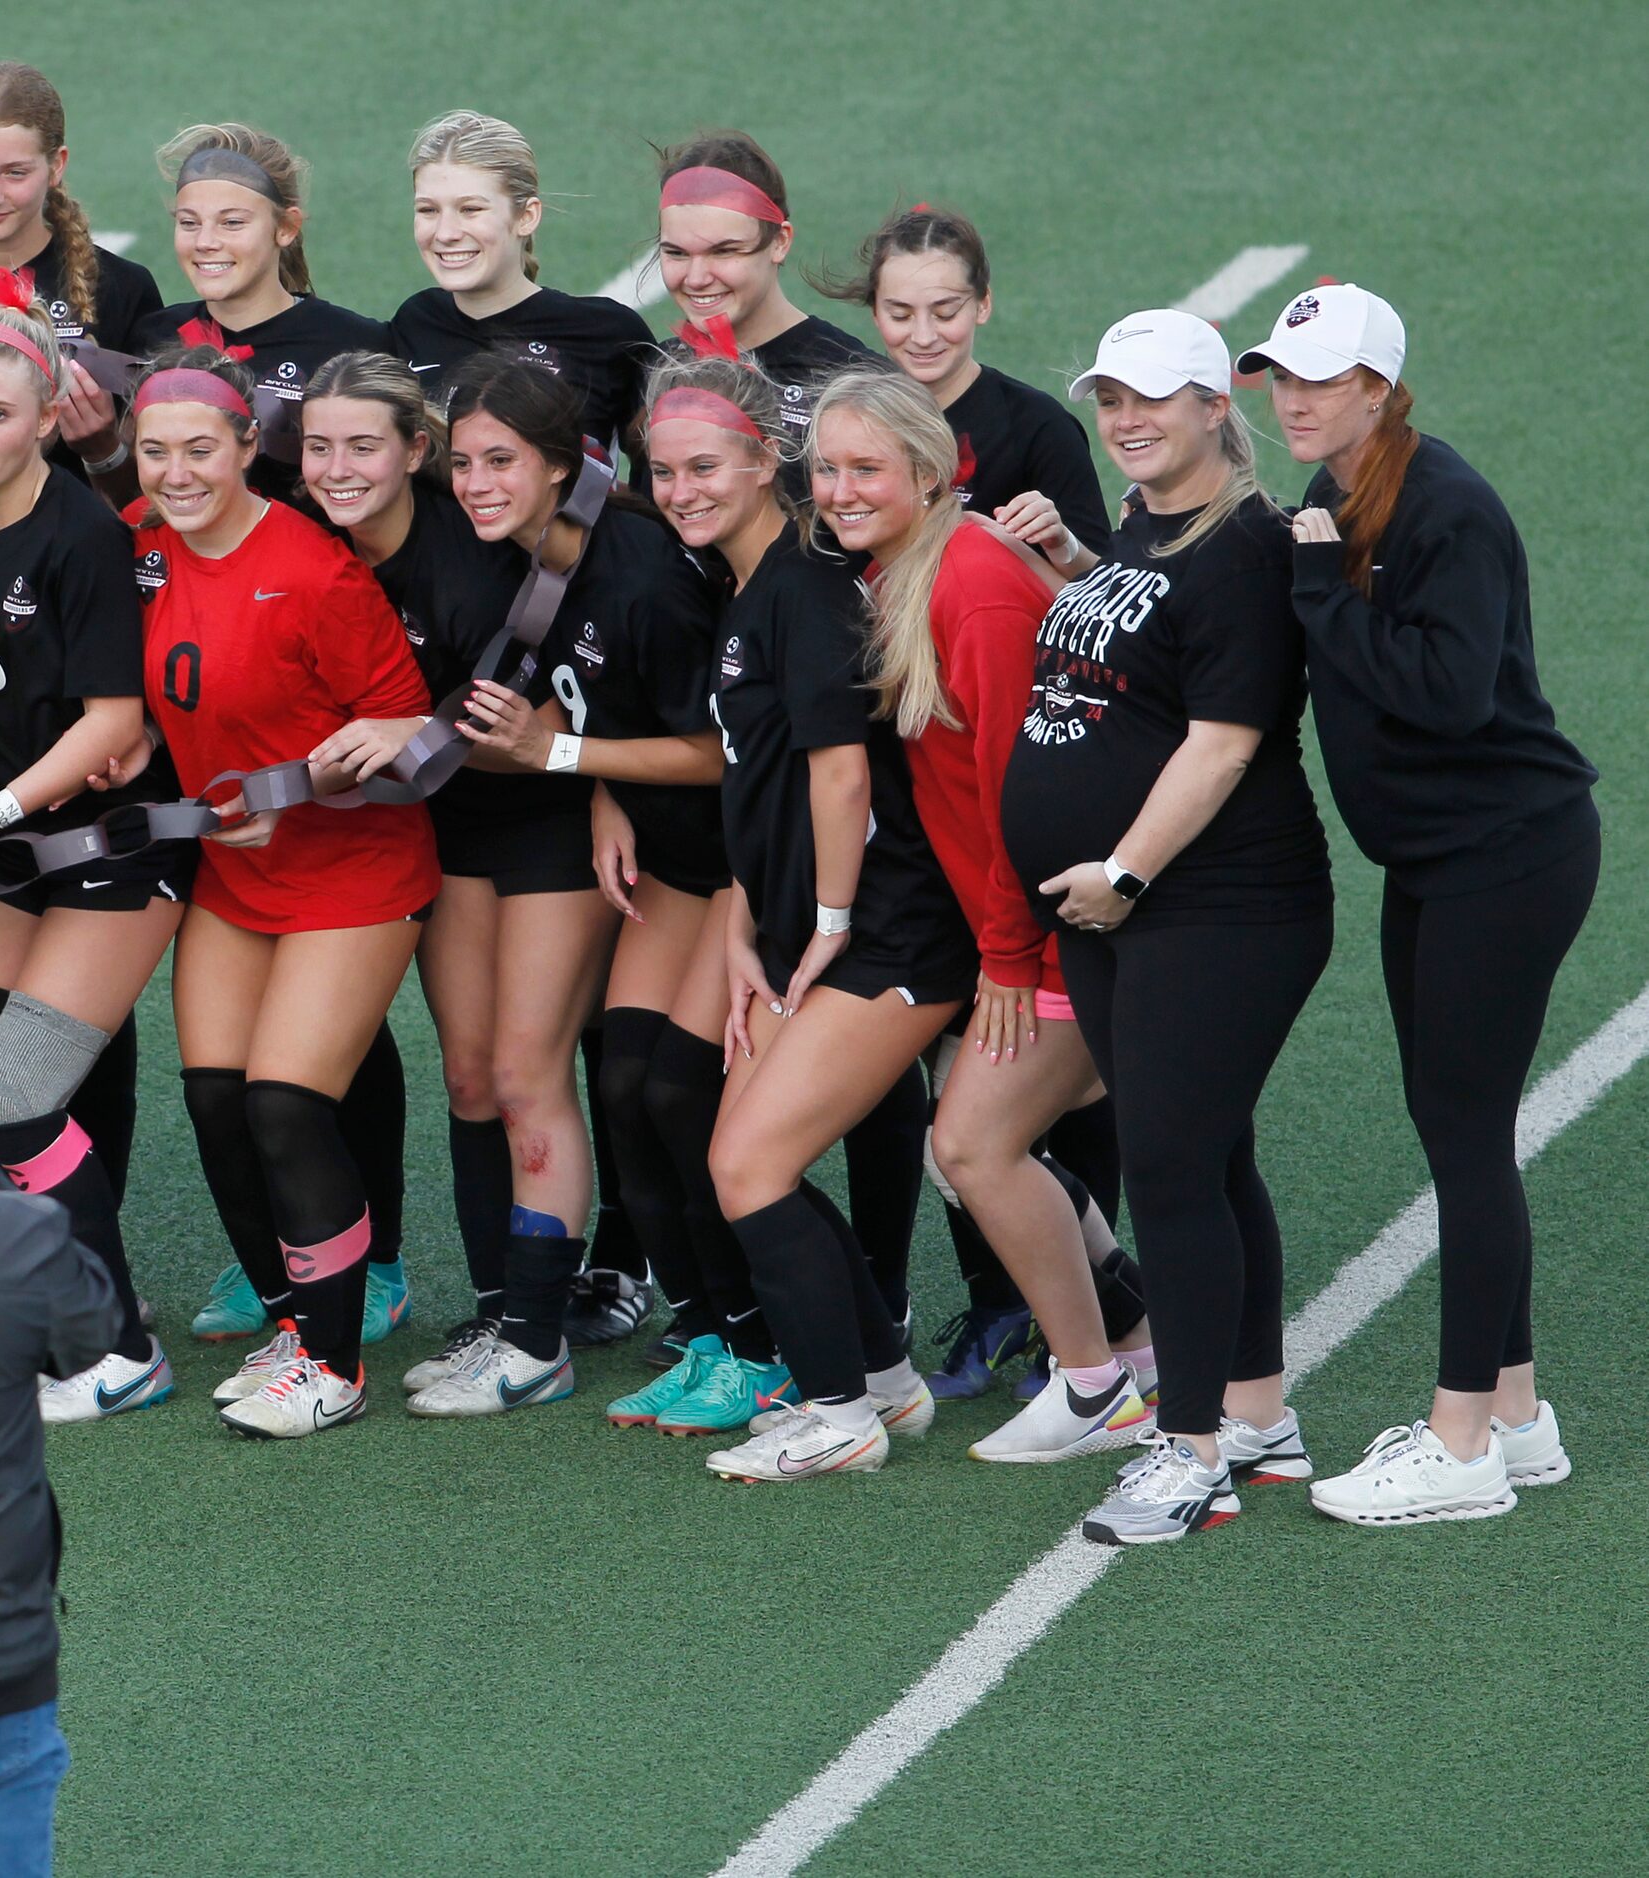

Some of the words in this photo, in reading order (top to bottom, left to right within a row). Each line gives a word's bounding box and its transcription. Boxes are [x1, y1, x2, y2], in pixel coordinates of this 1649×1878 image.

[164, 641, 202, 713] 0
[552, 665, 588, 735] 9
[1085, 704, 1105, 721] 24
[285, 1250, 317, 1279] C
